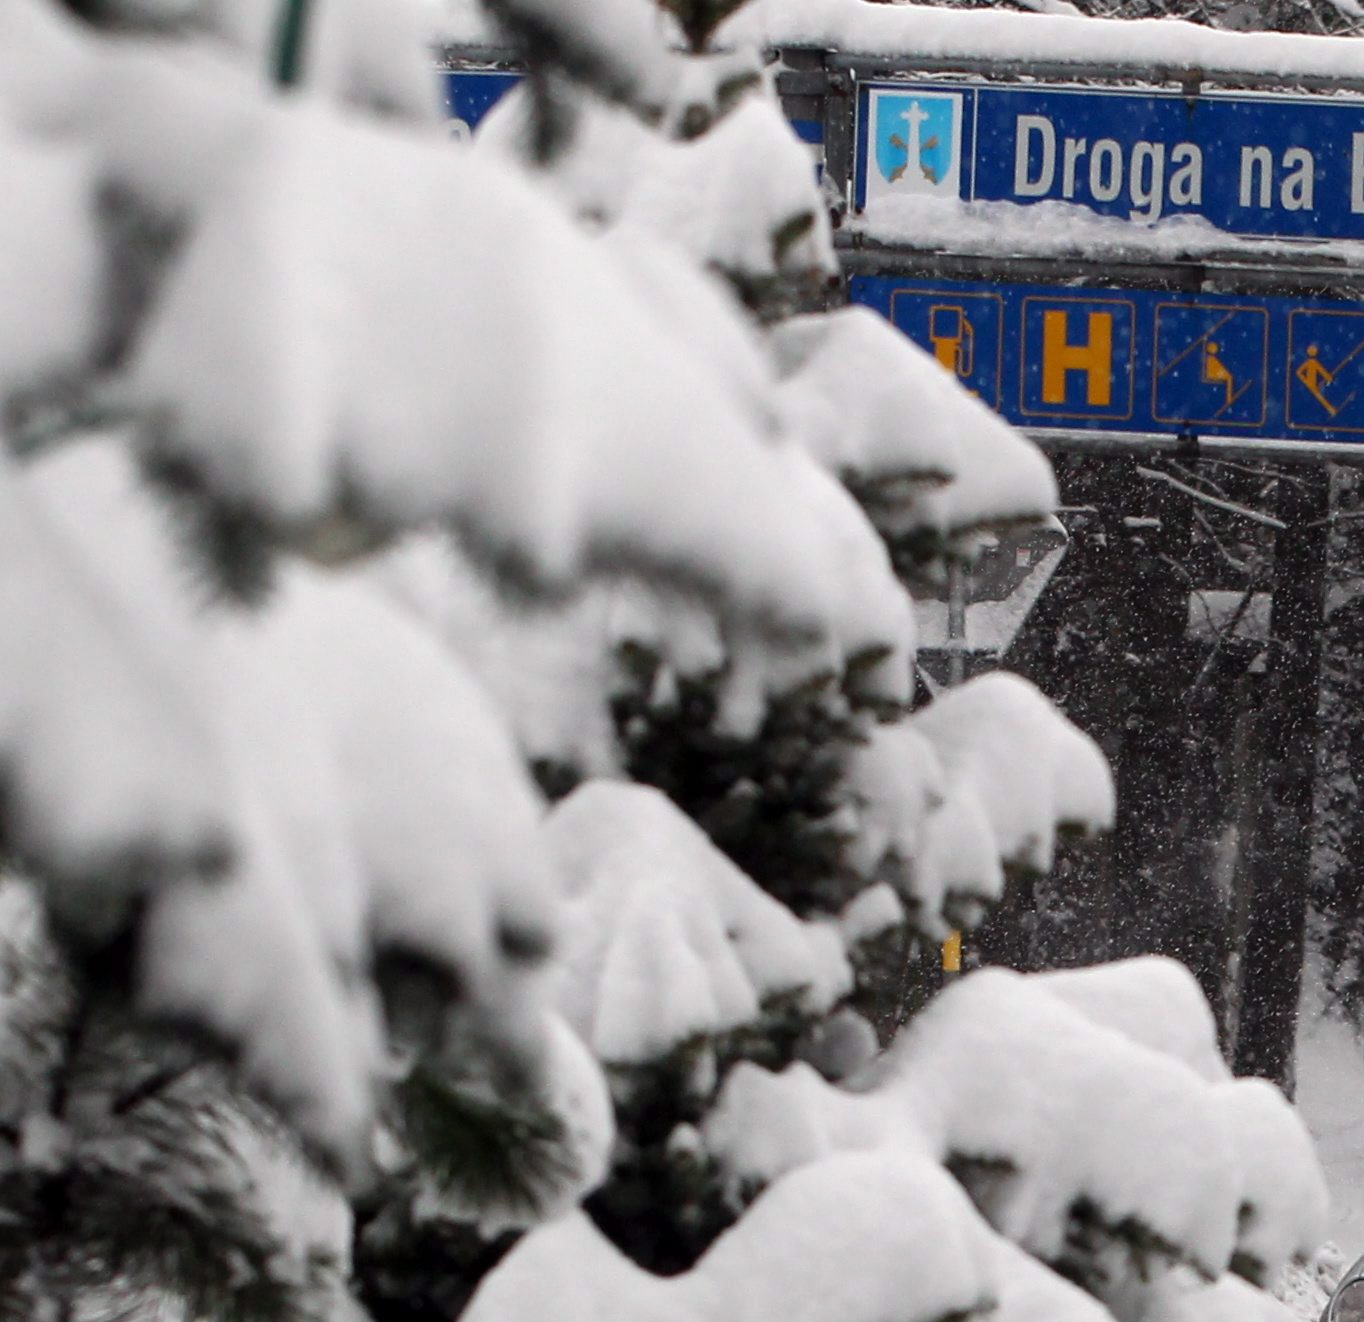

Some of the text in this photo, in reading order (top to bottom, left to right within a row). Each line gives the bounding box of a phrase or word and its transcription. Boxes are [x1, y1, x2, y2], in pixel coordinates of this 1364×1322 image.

[1014, 114, 1203, 224] Droga
[1239, 145, 1314, 211] na
[1042, 310, 1113, 406] H
